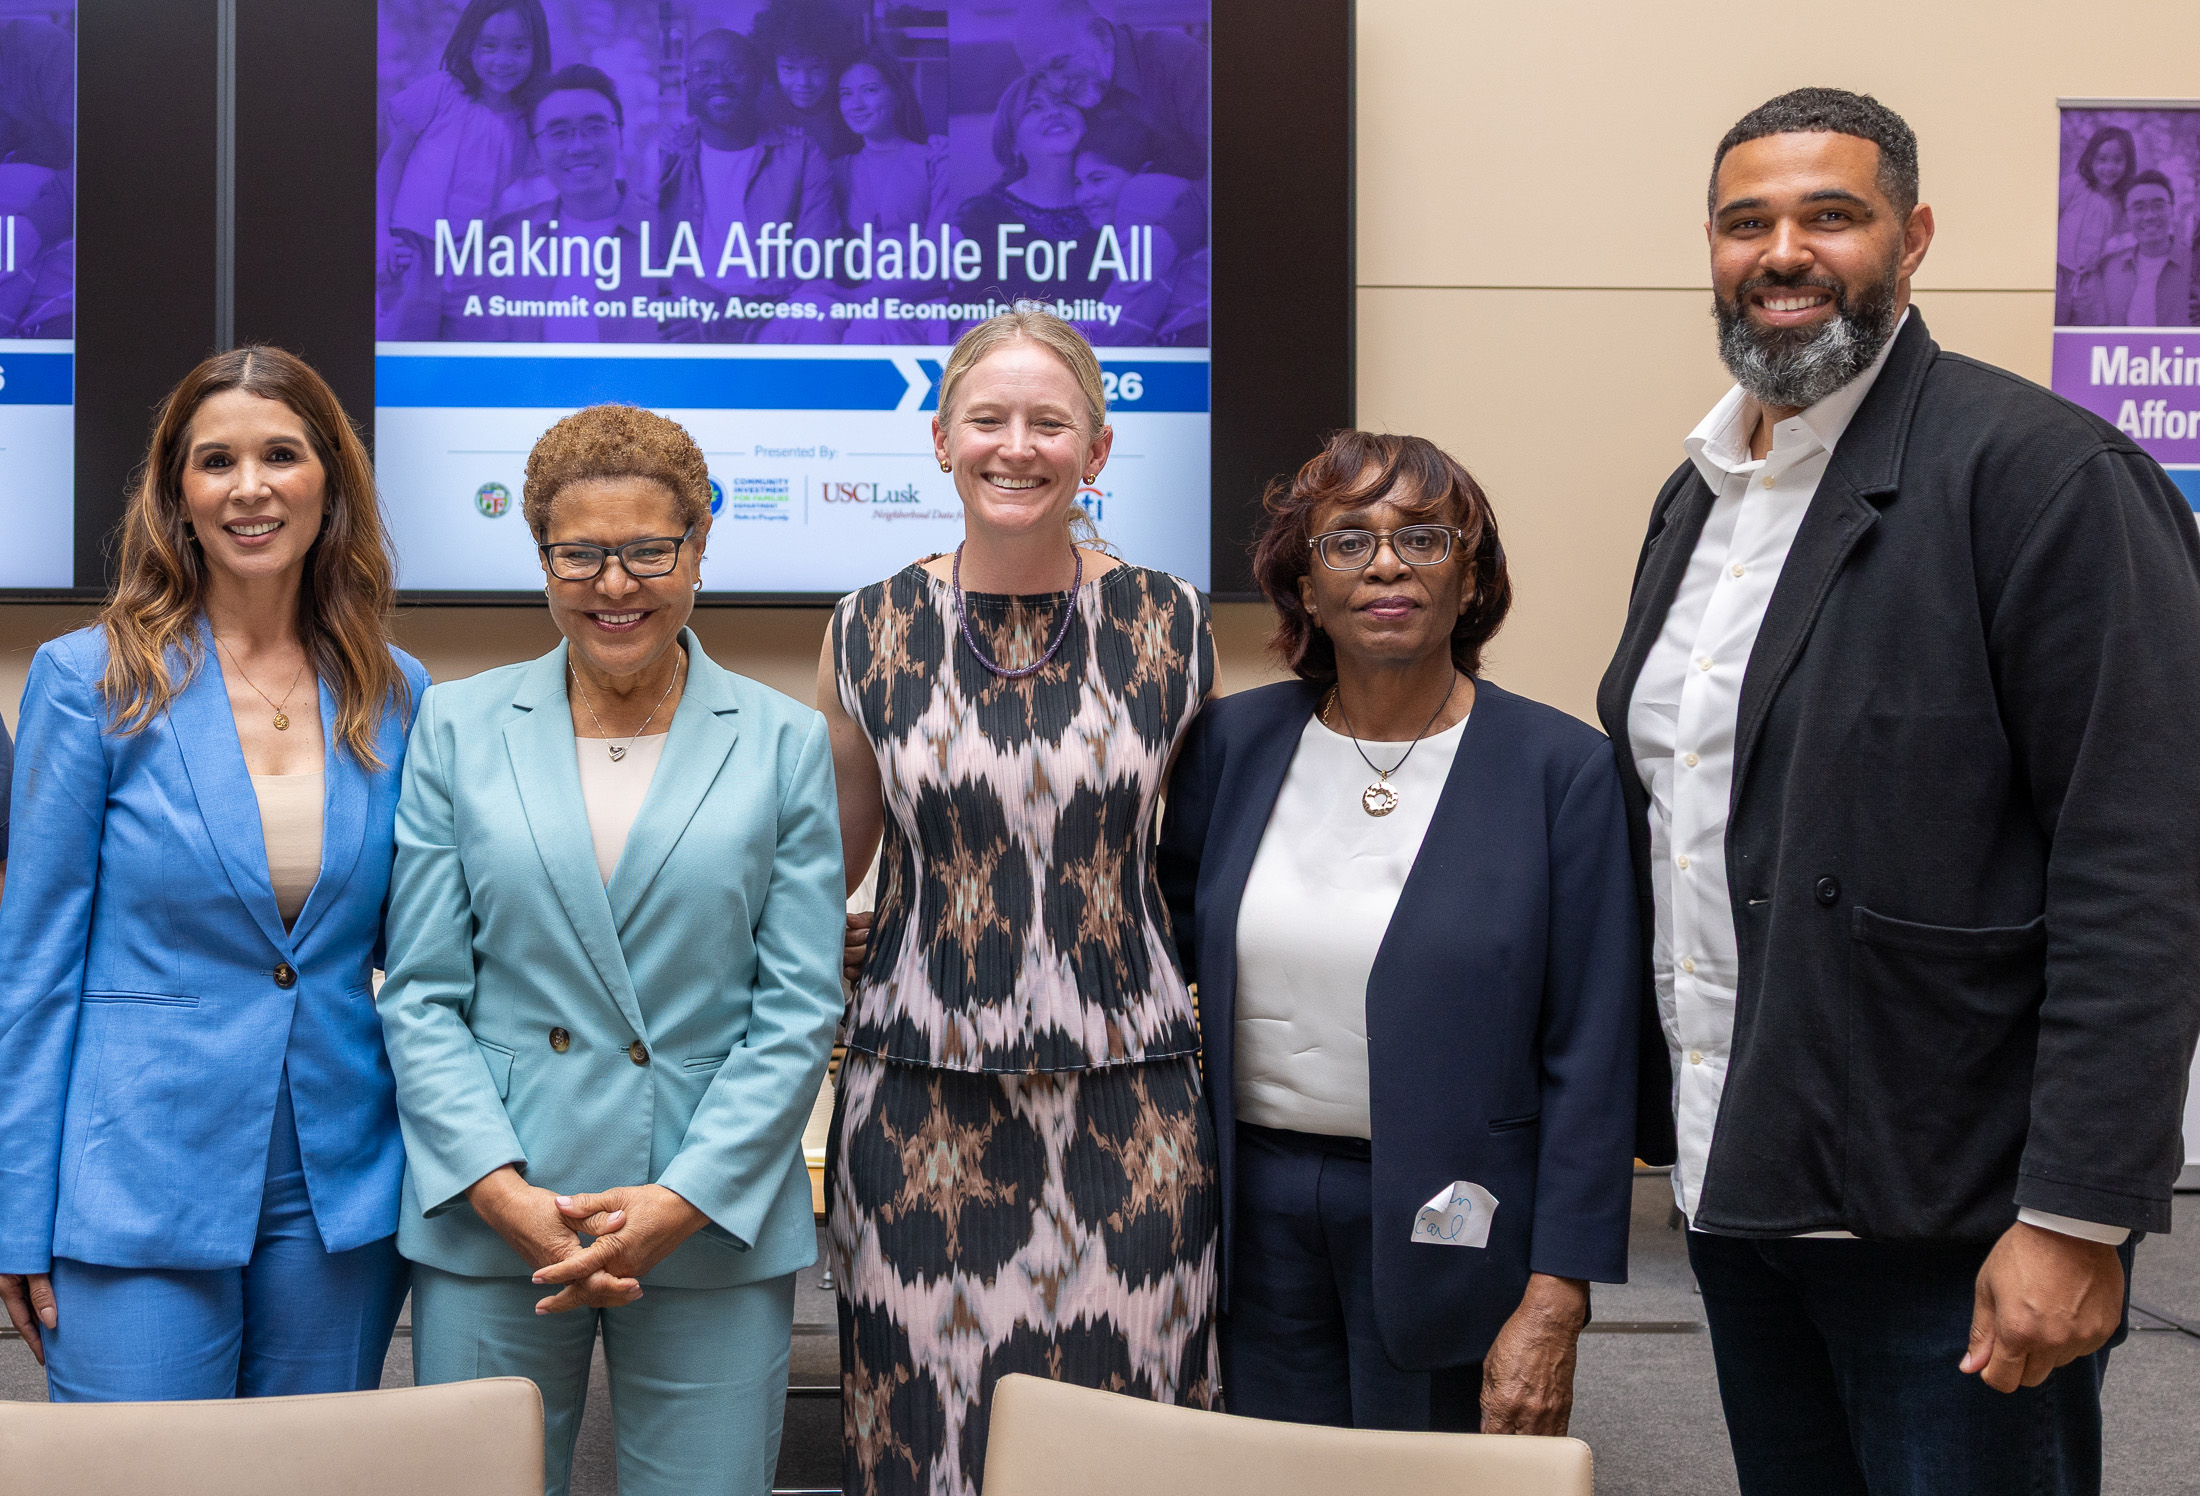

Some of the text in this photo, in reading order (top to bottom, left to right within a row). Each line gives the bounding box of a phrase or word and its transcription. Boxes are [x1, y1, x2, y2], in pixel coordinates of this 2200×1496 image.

[434, 218, 1152, 291] Making LA Affordable For All
[463, 295, 484, 317] A
[488, 295, 589, 318] Summit
[593, 300, 627, 318] on
[632, 296, 720, 323] Equity,
[724, 297, 826, 321] Access,
[830, 297, 879, 320] and
[884, 298, 1010, 321] Economic
[2090, 345, 2200, 386] Makin
[1101, 371, 1144, 401] 26
[2117, 399, 2200, 440] Affor
[754, 444, 816, 458] Presented
